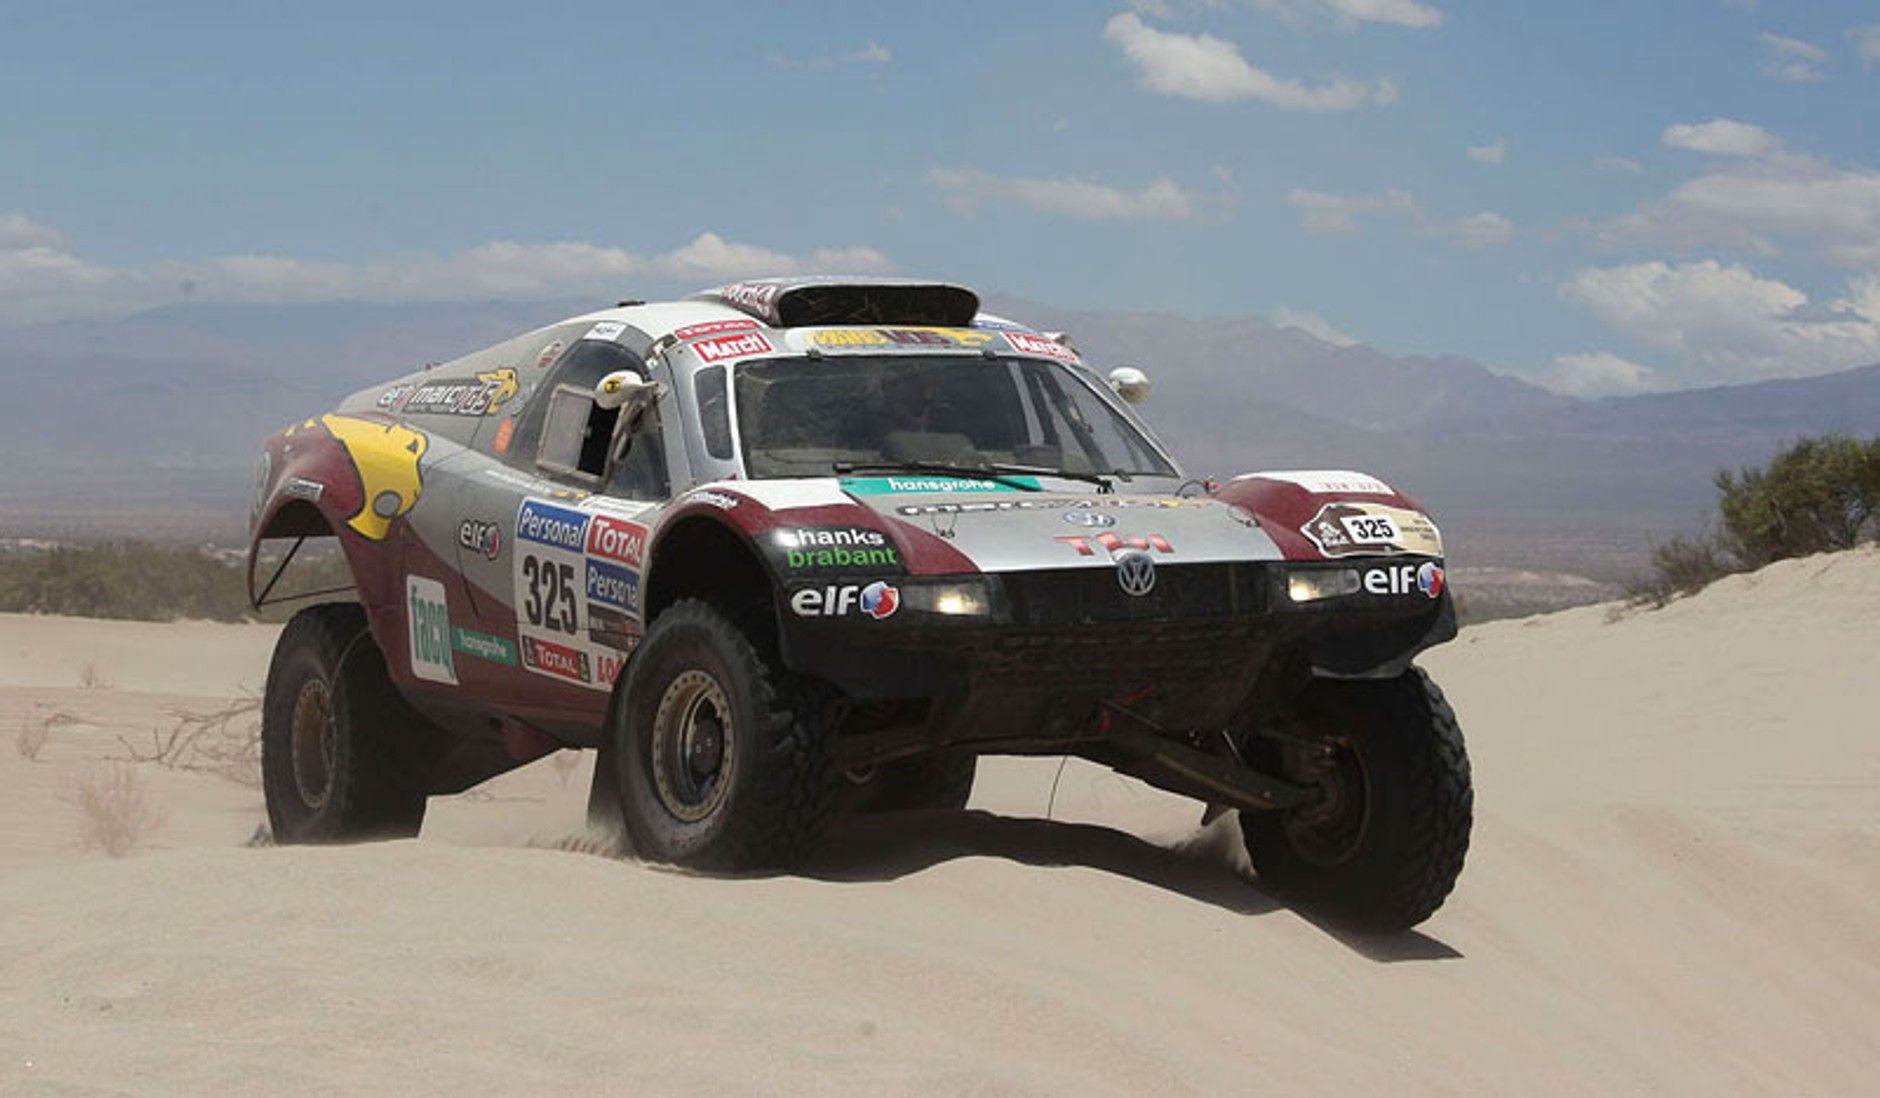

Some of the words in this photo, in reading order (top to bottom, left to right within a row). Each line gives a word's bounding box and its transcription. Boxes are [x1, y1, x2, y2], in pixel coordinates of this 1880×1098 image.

[887, 477, 995, 491] hansgrohe
[461, 522, 485, 548] elf
[520, 507, 588, 547] Personal
[594, 519, 641, 563] TOTAL
[1351, 518, 1394, 540] 325
[787, 548, 897, 567] brabant
[523, 554, 577, 635] 325
[1364, 566, 1416, 594] elf
[791, 585, 859, 616] elf
[535, 643, 578, 674] TOTAL
